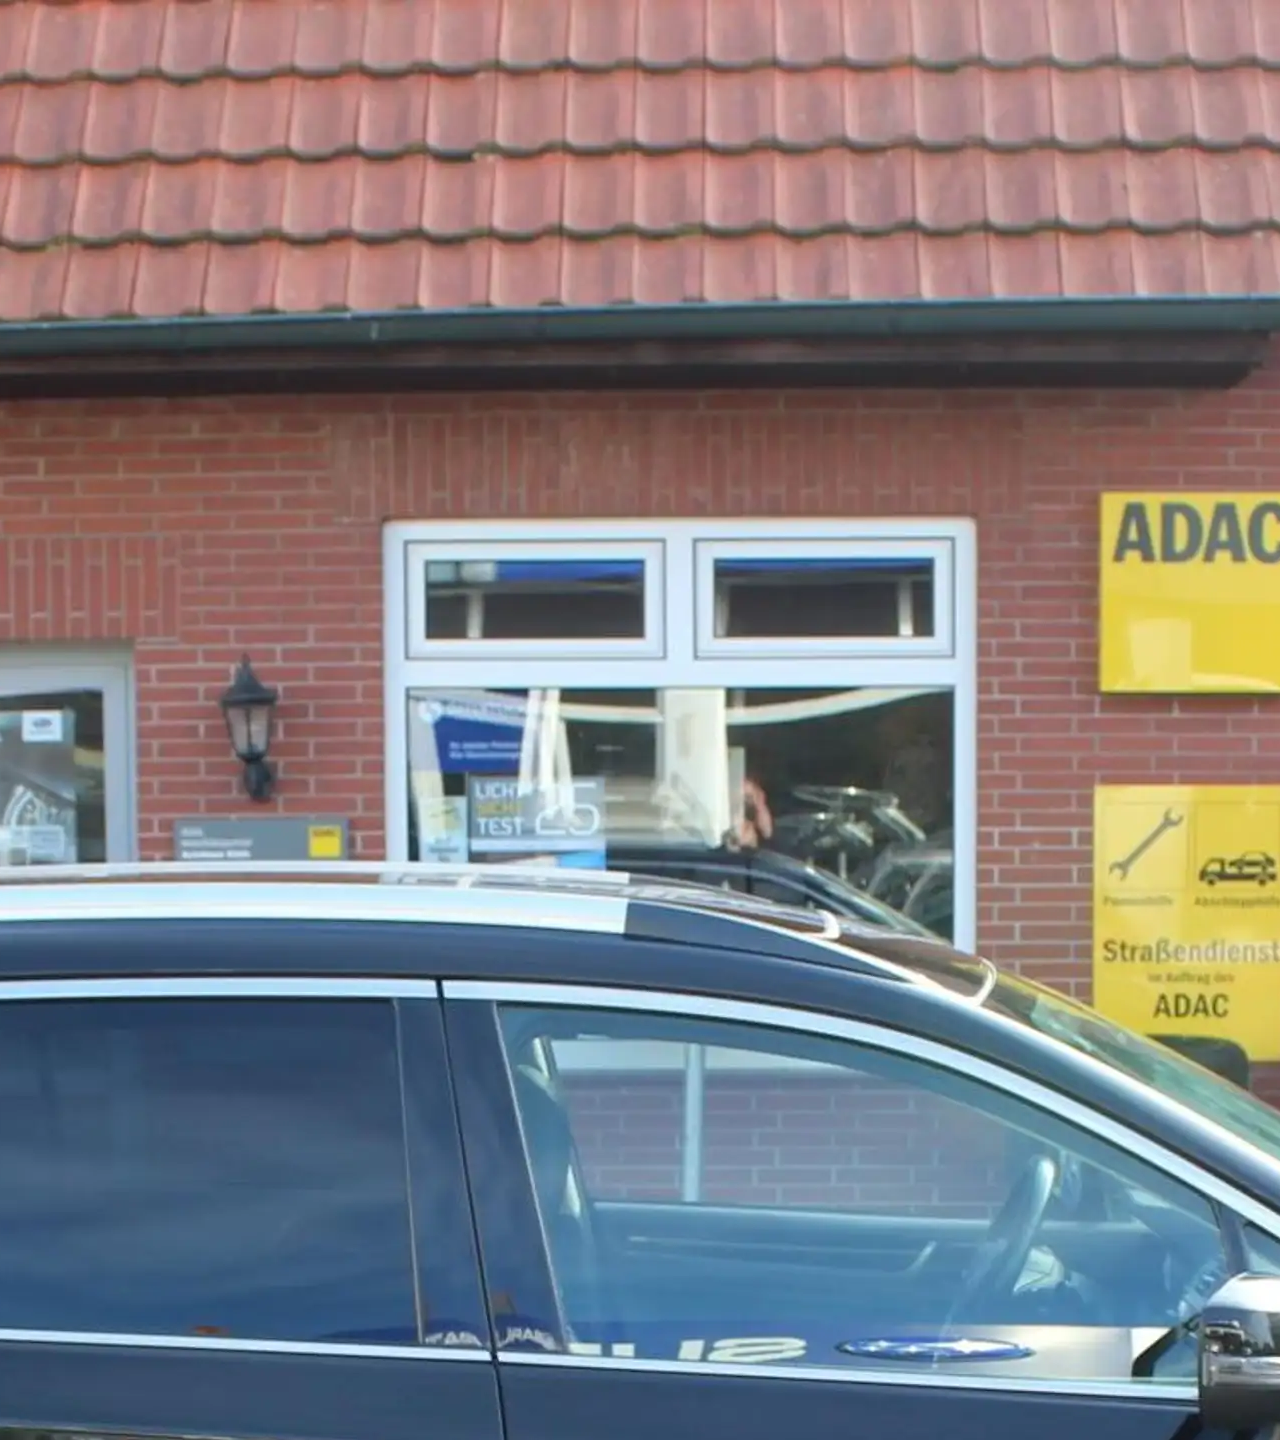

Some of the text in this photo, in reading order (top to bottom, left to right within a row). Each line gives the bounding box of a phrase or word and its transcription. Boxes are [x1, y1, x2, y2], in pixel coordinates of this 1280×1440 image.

[477, 817, 525, 836] TEST
[1103, 938, 1280, 964] Straßendienst
[1153, 993, 1229, 1019] ADAC
